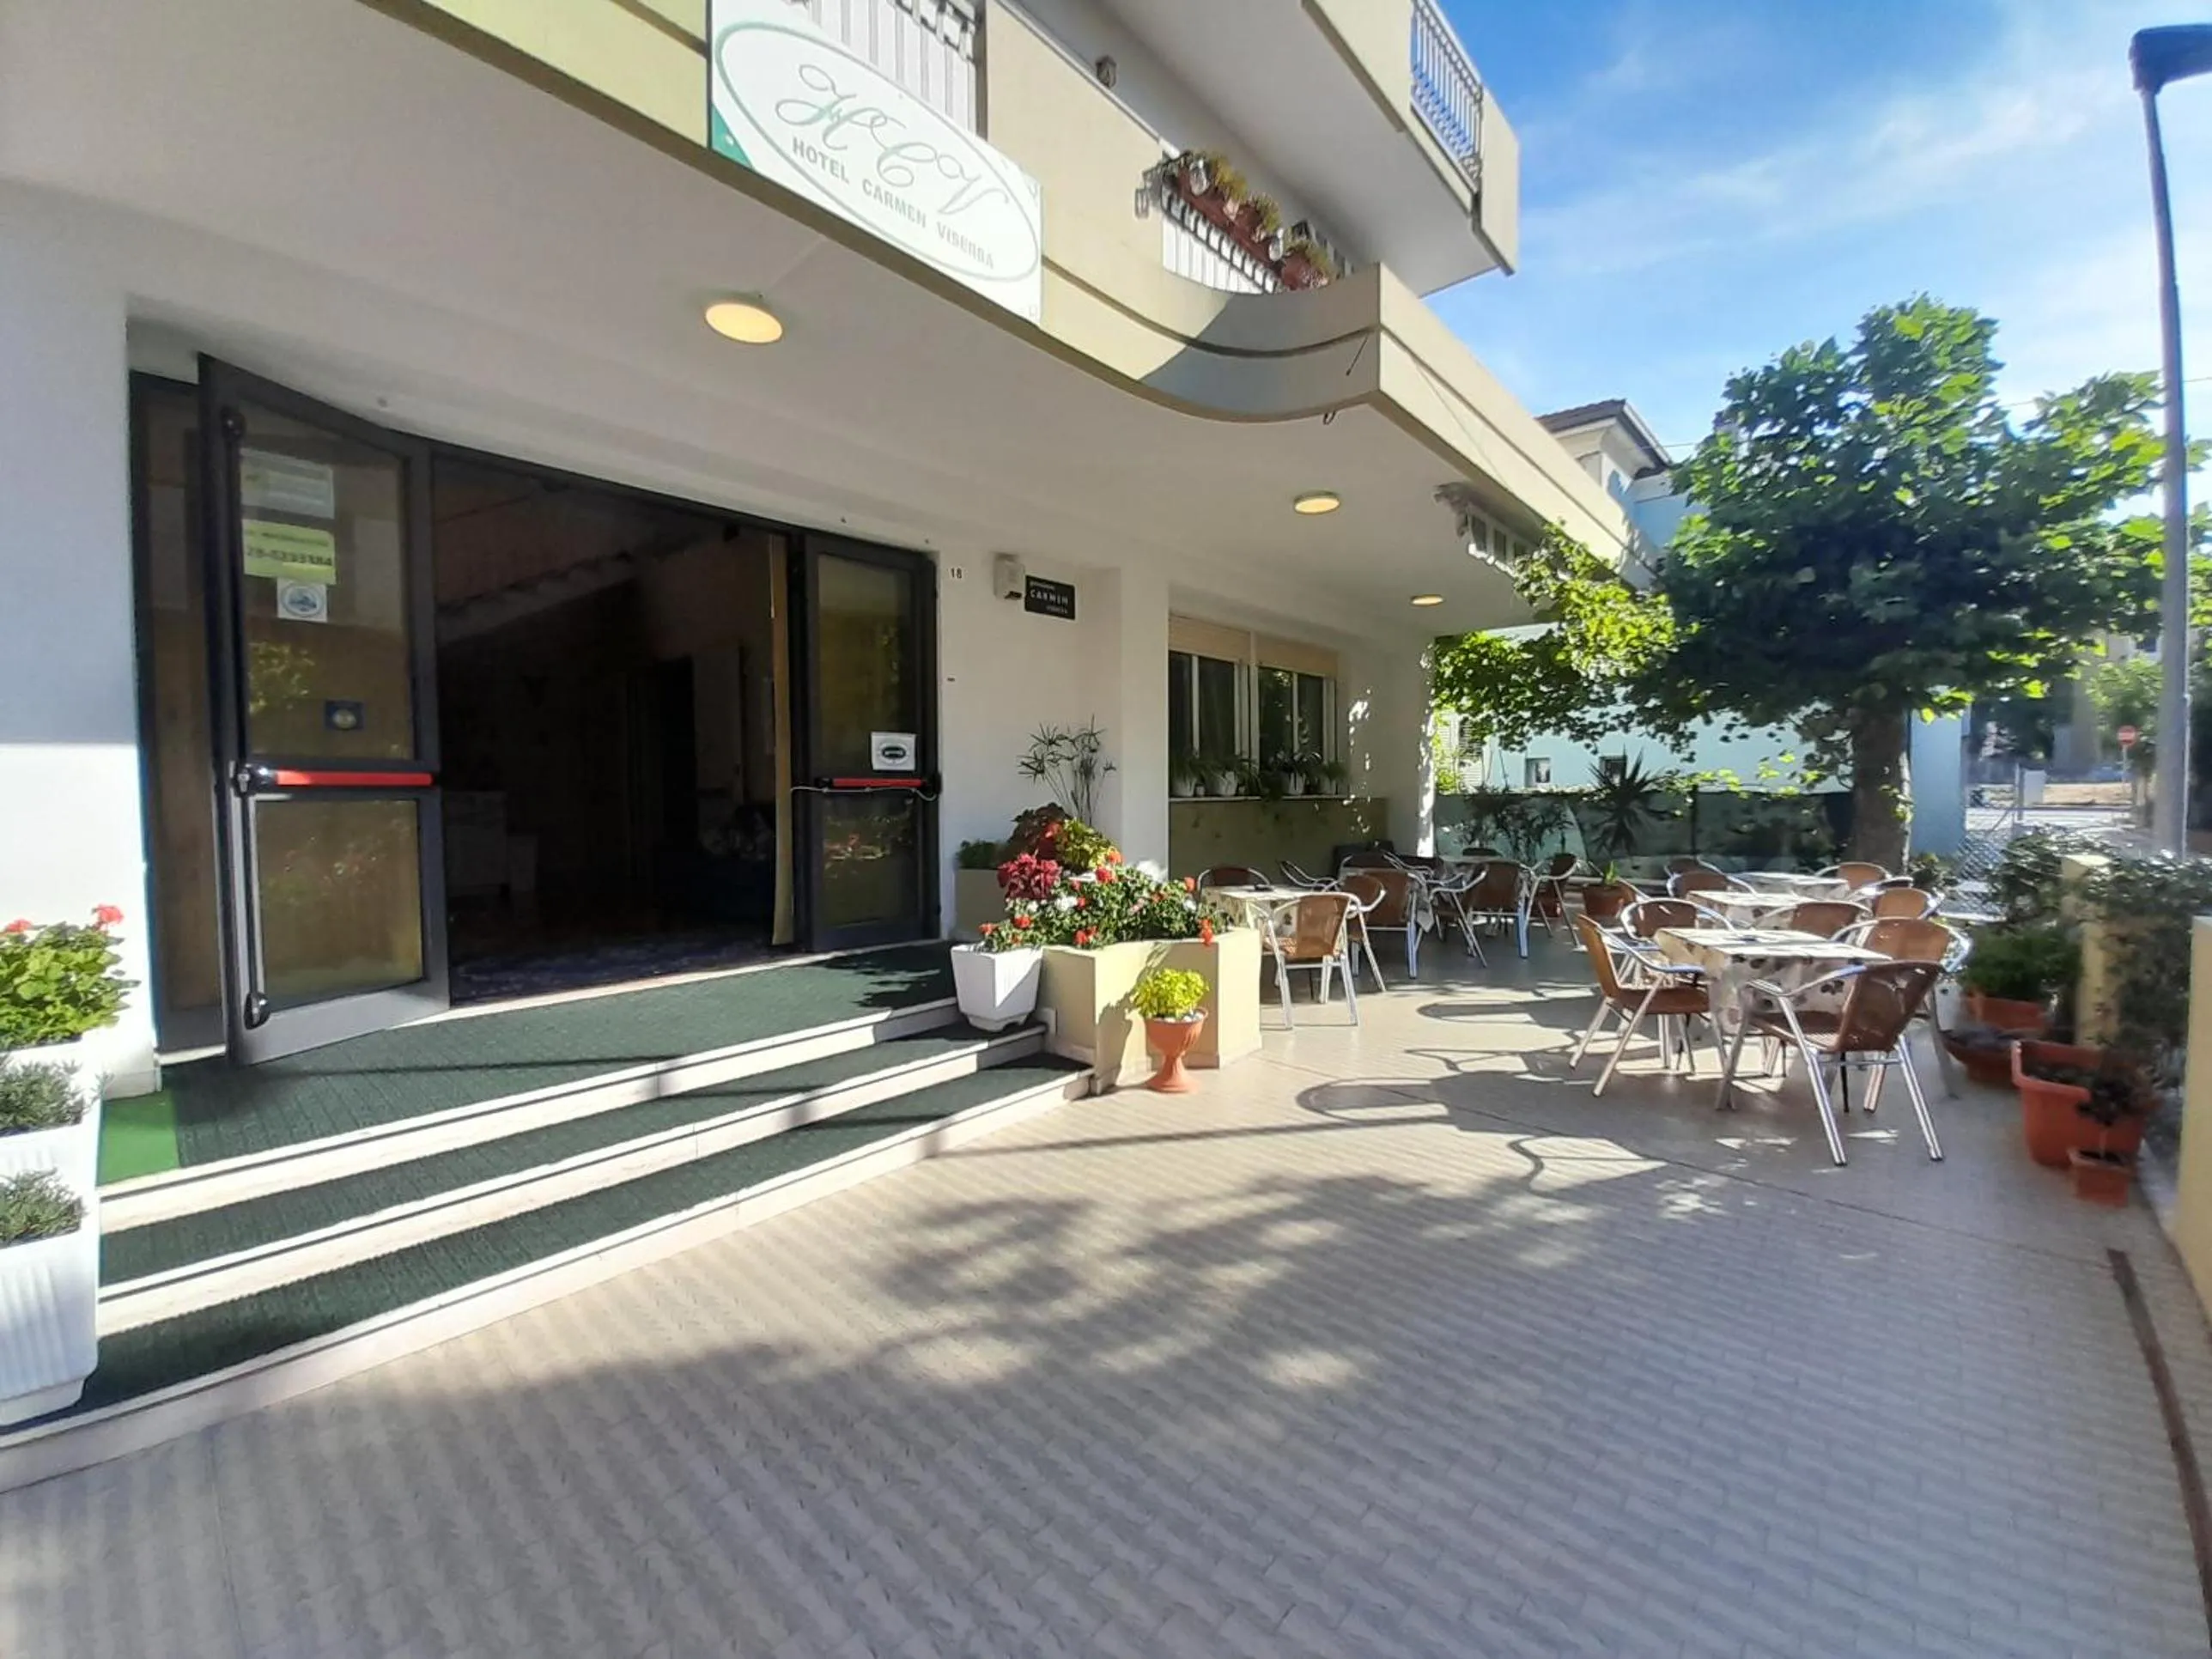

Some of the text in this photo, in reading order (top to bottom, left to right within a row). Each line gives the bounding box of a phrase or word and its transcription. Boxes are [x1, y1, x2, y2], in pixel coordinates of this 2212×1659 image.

[792, 136, 850, 185] HOTEL
[862, 177, 927, 228] CARMEN
[951, 568, 963, 579] 18
